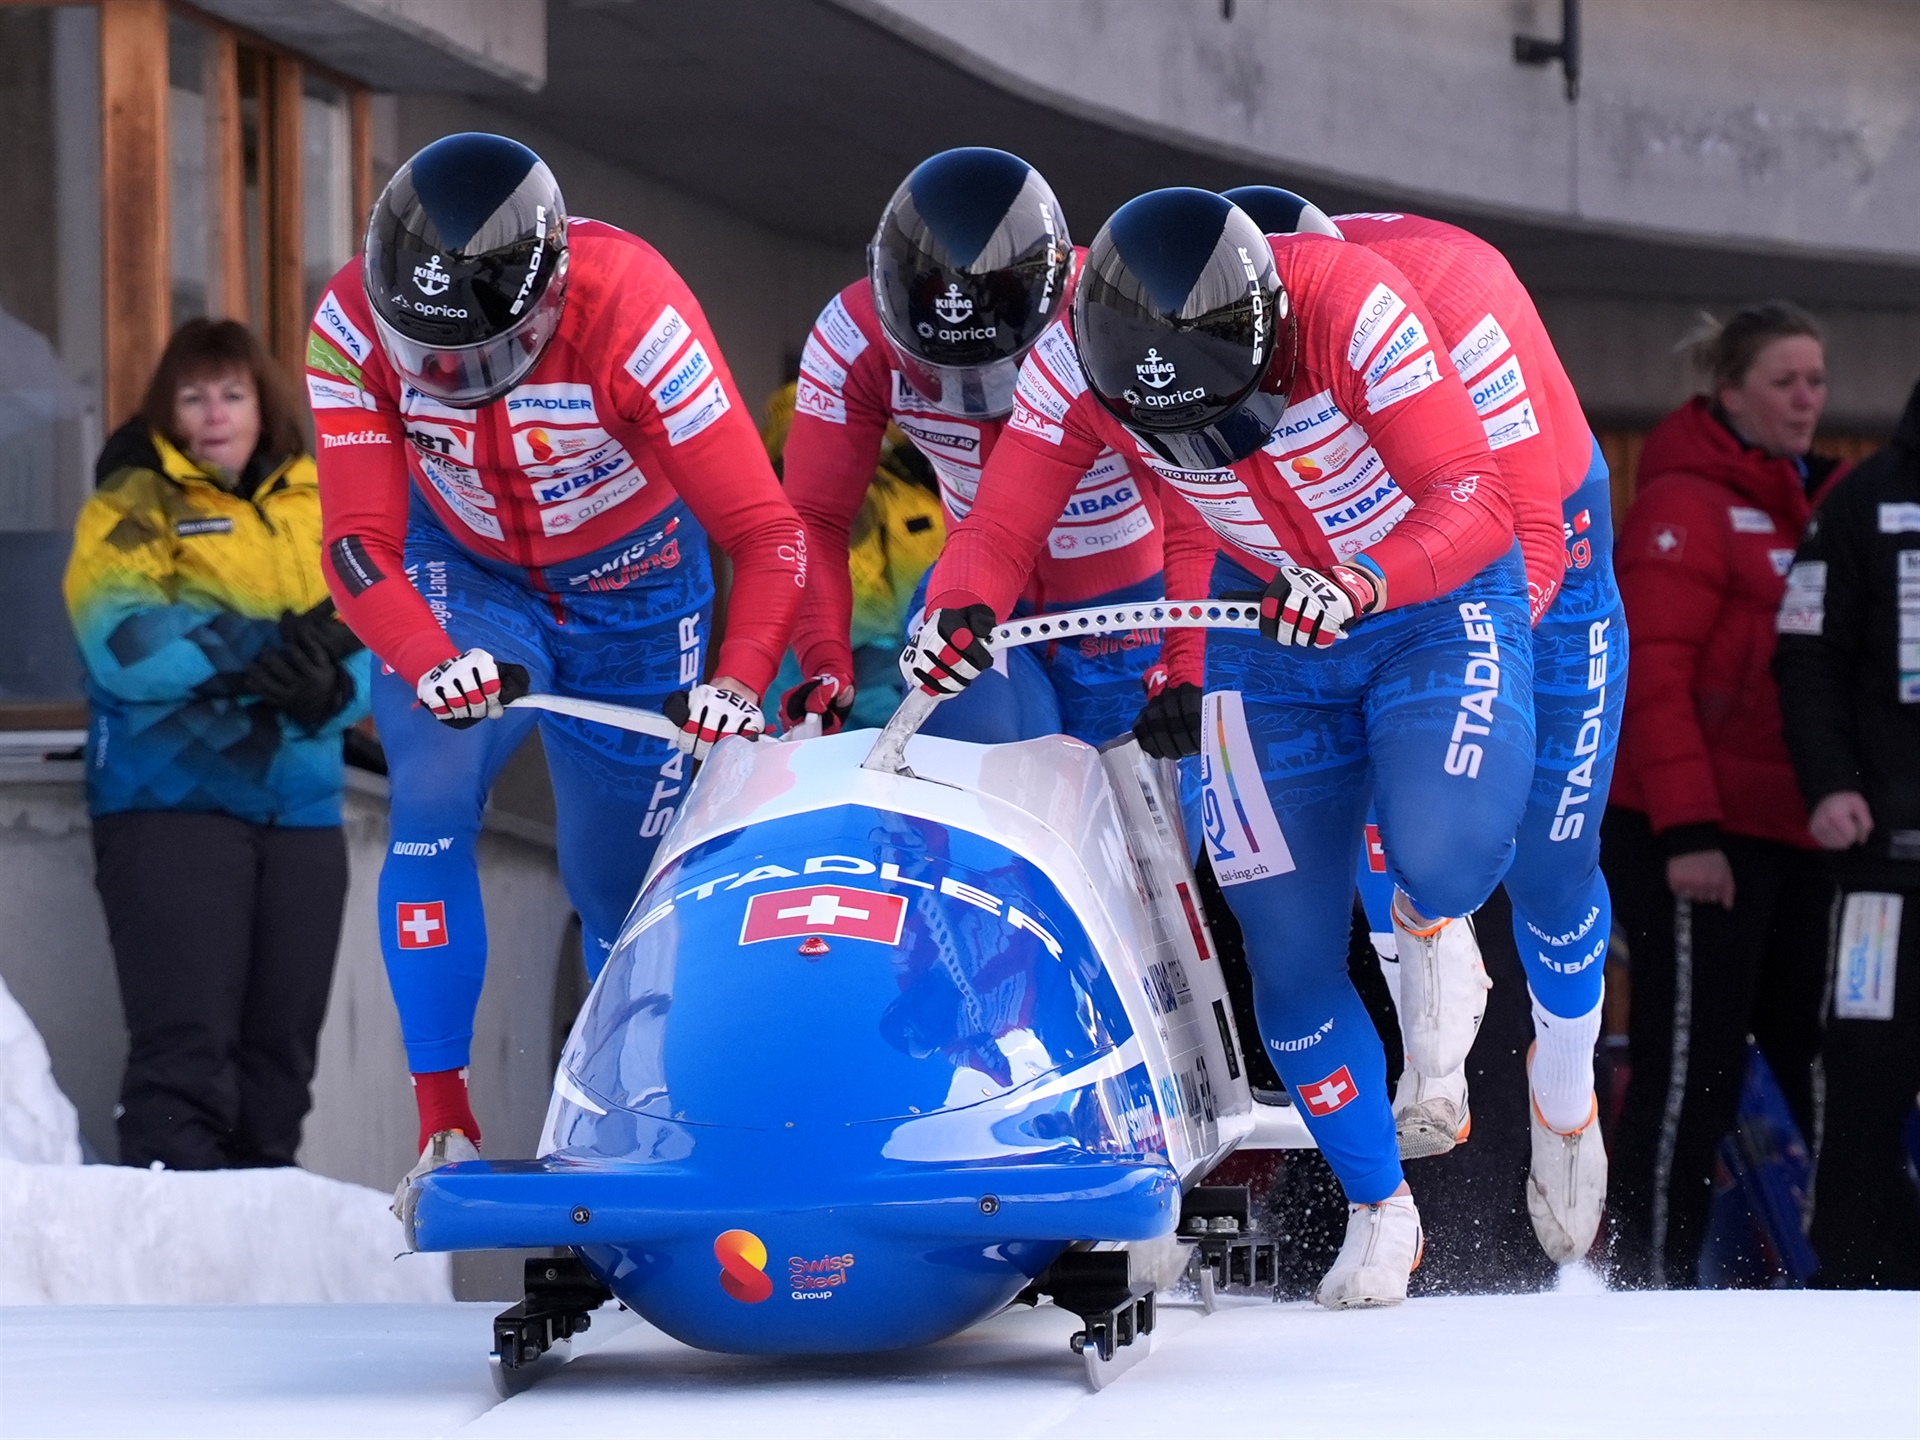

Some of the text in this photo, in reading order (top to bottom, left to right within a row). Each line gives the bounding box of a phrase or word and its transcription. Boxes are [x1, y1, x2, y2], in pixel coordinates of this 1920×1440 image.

[510, 205, 547, 316] STADLER
[1036, 203, 1056, 314] STADLER
[413, 265, 450, 285] KIBAG
[414, 301, 468, 319] aprica
[935, 299, 973, 314] KIBAG
[1238, 247, 1264, 365] STADLER
[938, 327, 997, 343] aprica
[660, 352, 704, 400] KOHLER
[1136, 363, 1175, 375] KIBAG
[1145, 387, 1206, 408] aprica
[1473, 369, 1517, 405] OHLER
[508, 398, 592, 411] STADLER
[925, 432, 956, 445] KUNZ
[957, 438, 974, 448] AG
[1082, 464, 1115, 479] midt
[1184, 474, 1217, 482] KUNZ
[578, 476, 640, 513] aprica
[1085, 516, 1148, 546] aprica
[582, 538, 681, 592] liding
[794, 530, 807, 588] OMEGA
[1288, 568, 1337, 609] SEIZ
[715, 689, 759, 715] SEIZ
[1444, 601, 1498, 779] STADLER
[640, 613, 700, 838] STAER
[1550, 617, 1610, 841] STADLER
[1220, 863, 1269, 882] ksl-ing.ch
[620, 855, 1064, 962] STADLER
[1539, 939, 1604, 974] KIBAG
[788, 1253, 855, 1274] Swiss
[790, 1268, 847, 1290] Steel
[791, 1291, 832, 1300] Group
